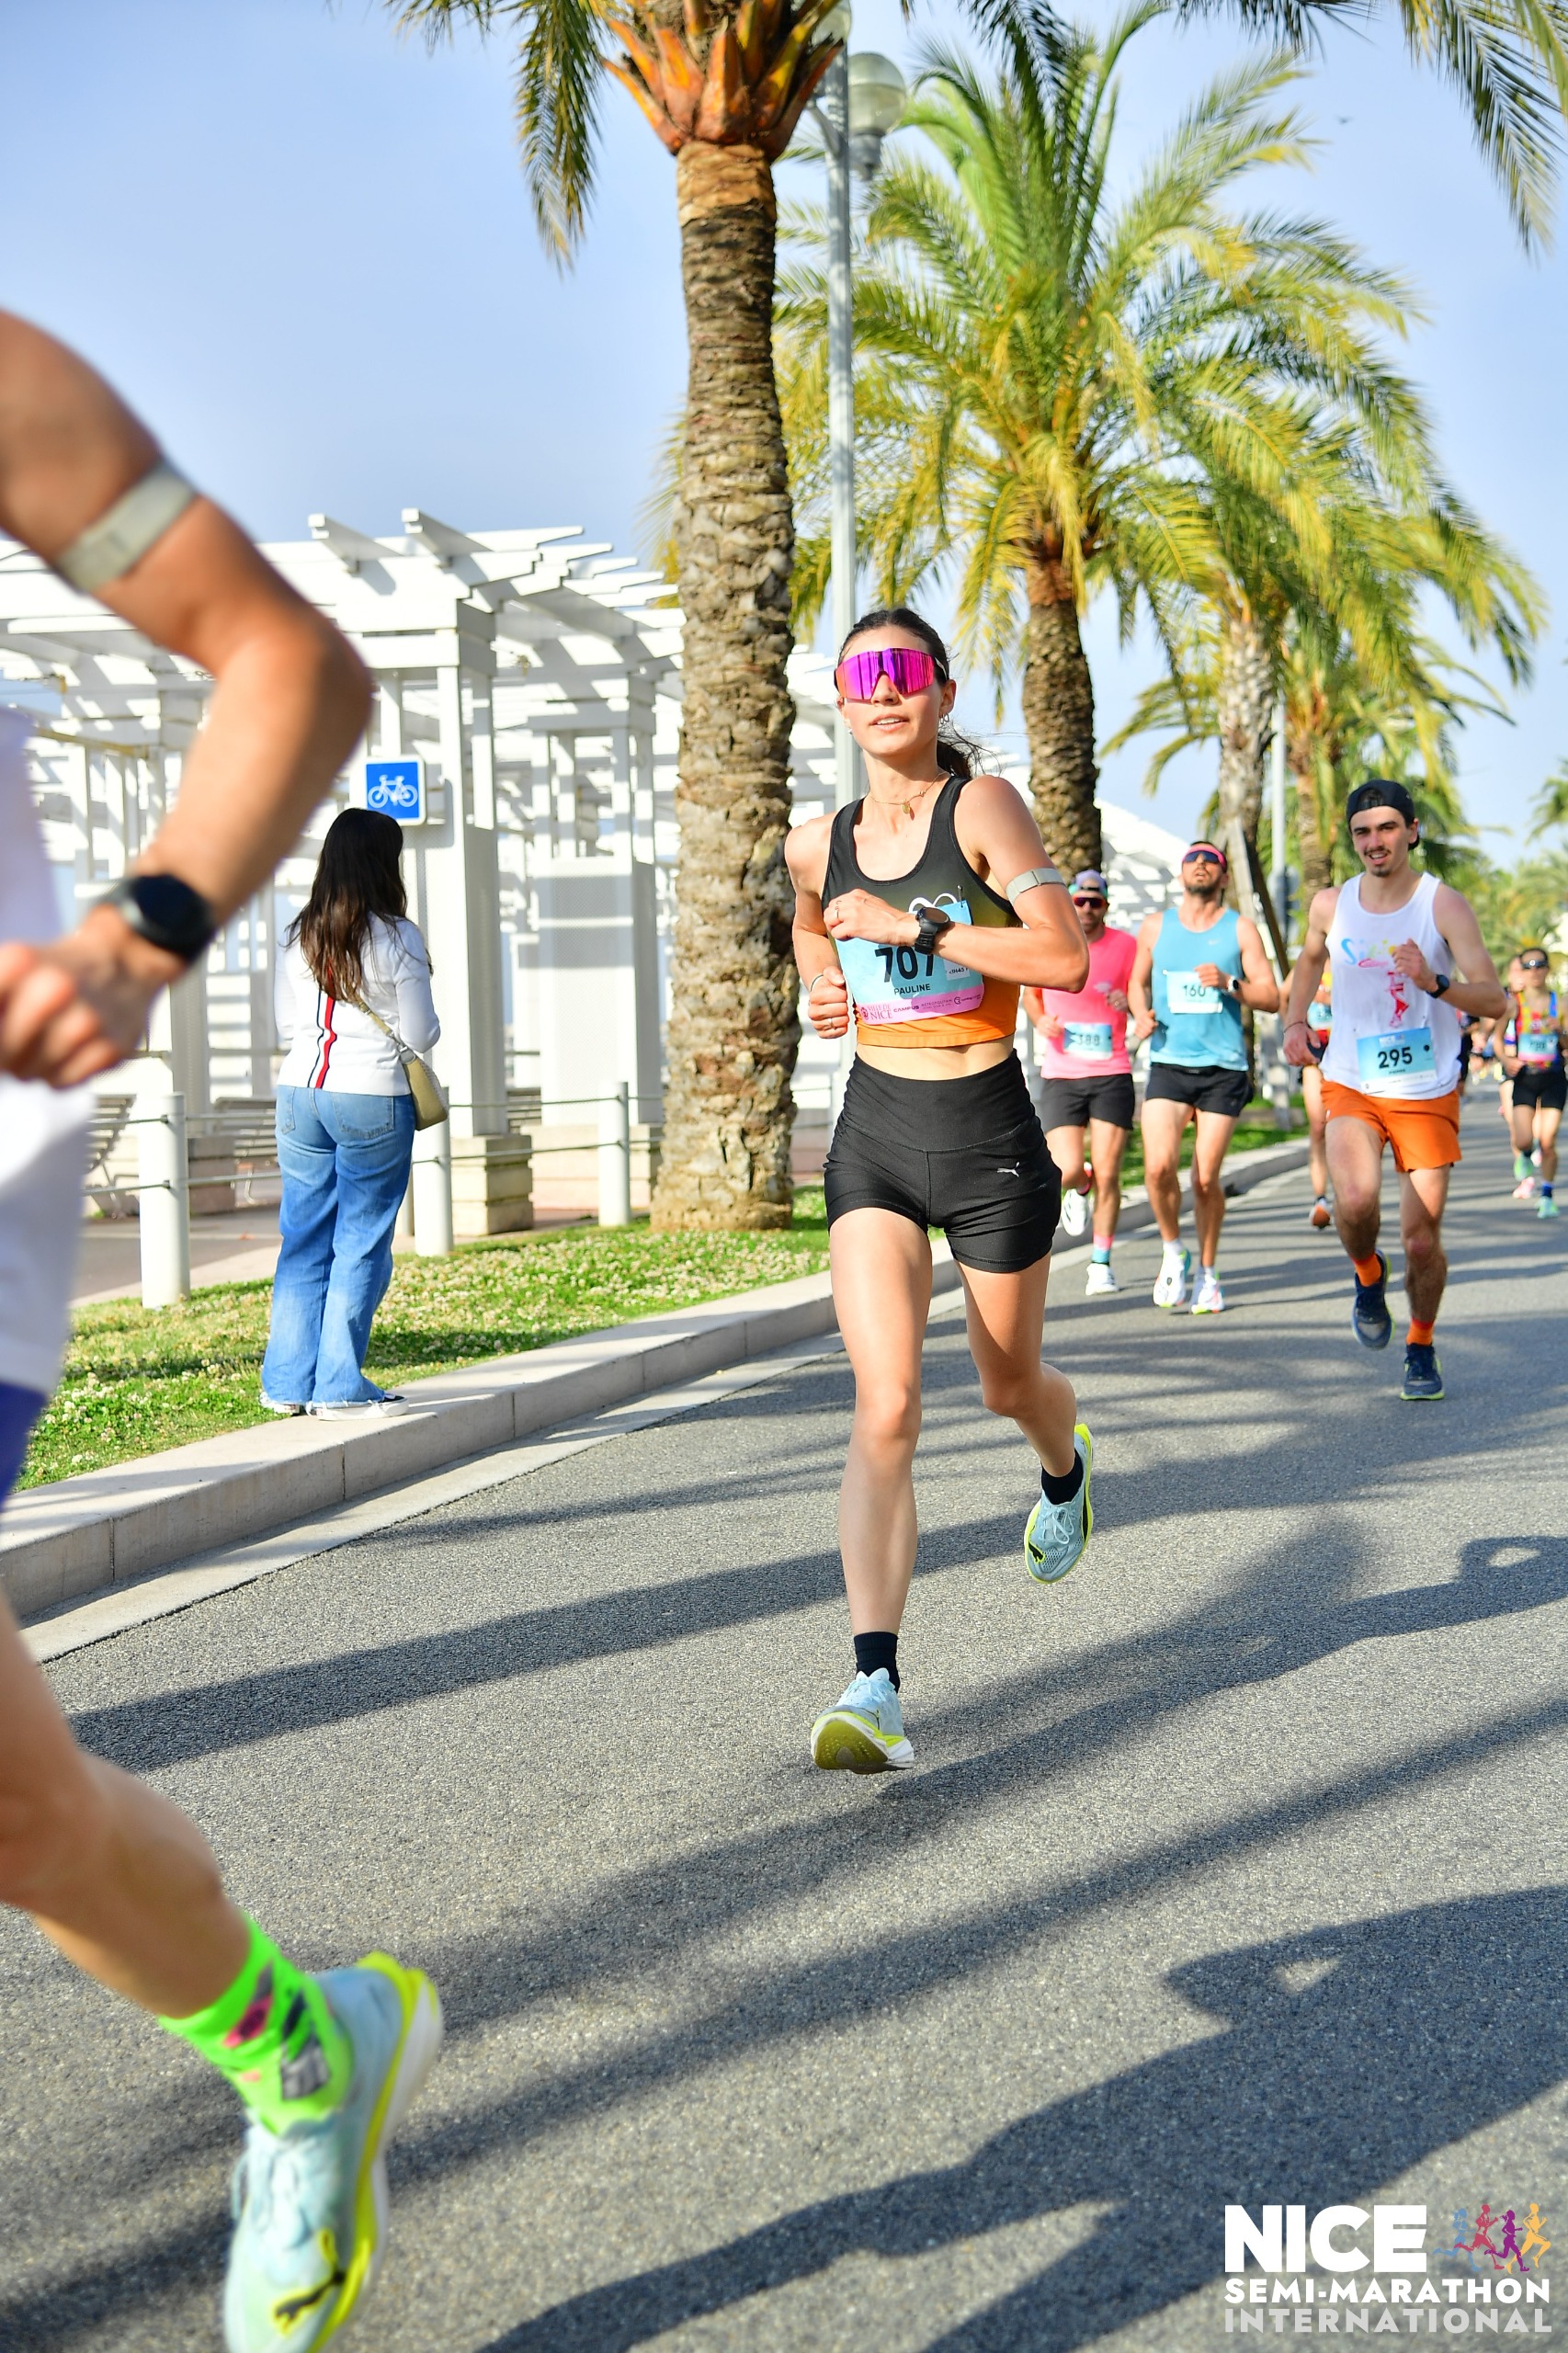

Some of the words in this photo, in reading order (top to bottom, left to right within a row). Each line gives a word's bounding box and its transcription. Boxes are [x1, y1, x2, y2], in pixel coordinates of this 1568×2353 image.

[893, 983, 931, 995] PAULINE
[1183, 984, 1206, 997] 160
[869, 1010, 893, 1020] NICE
[1377, 1046, 1413, 1069] 295
